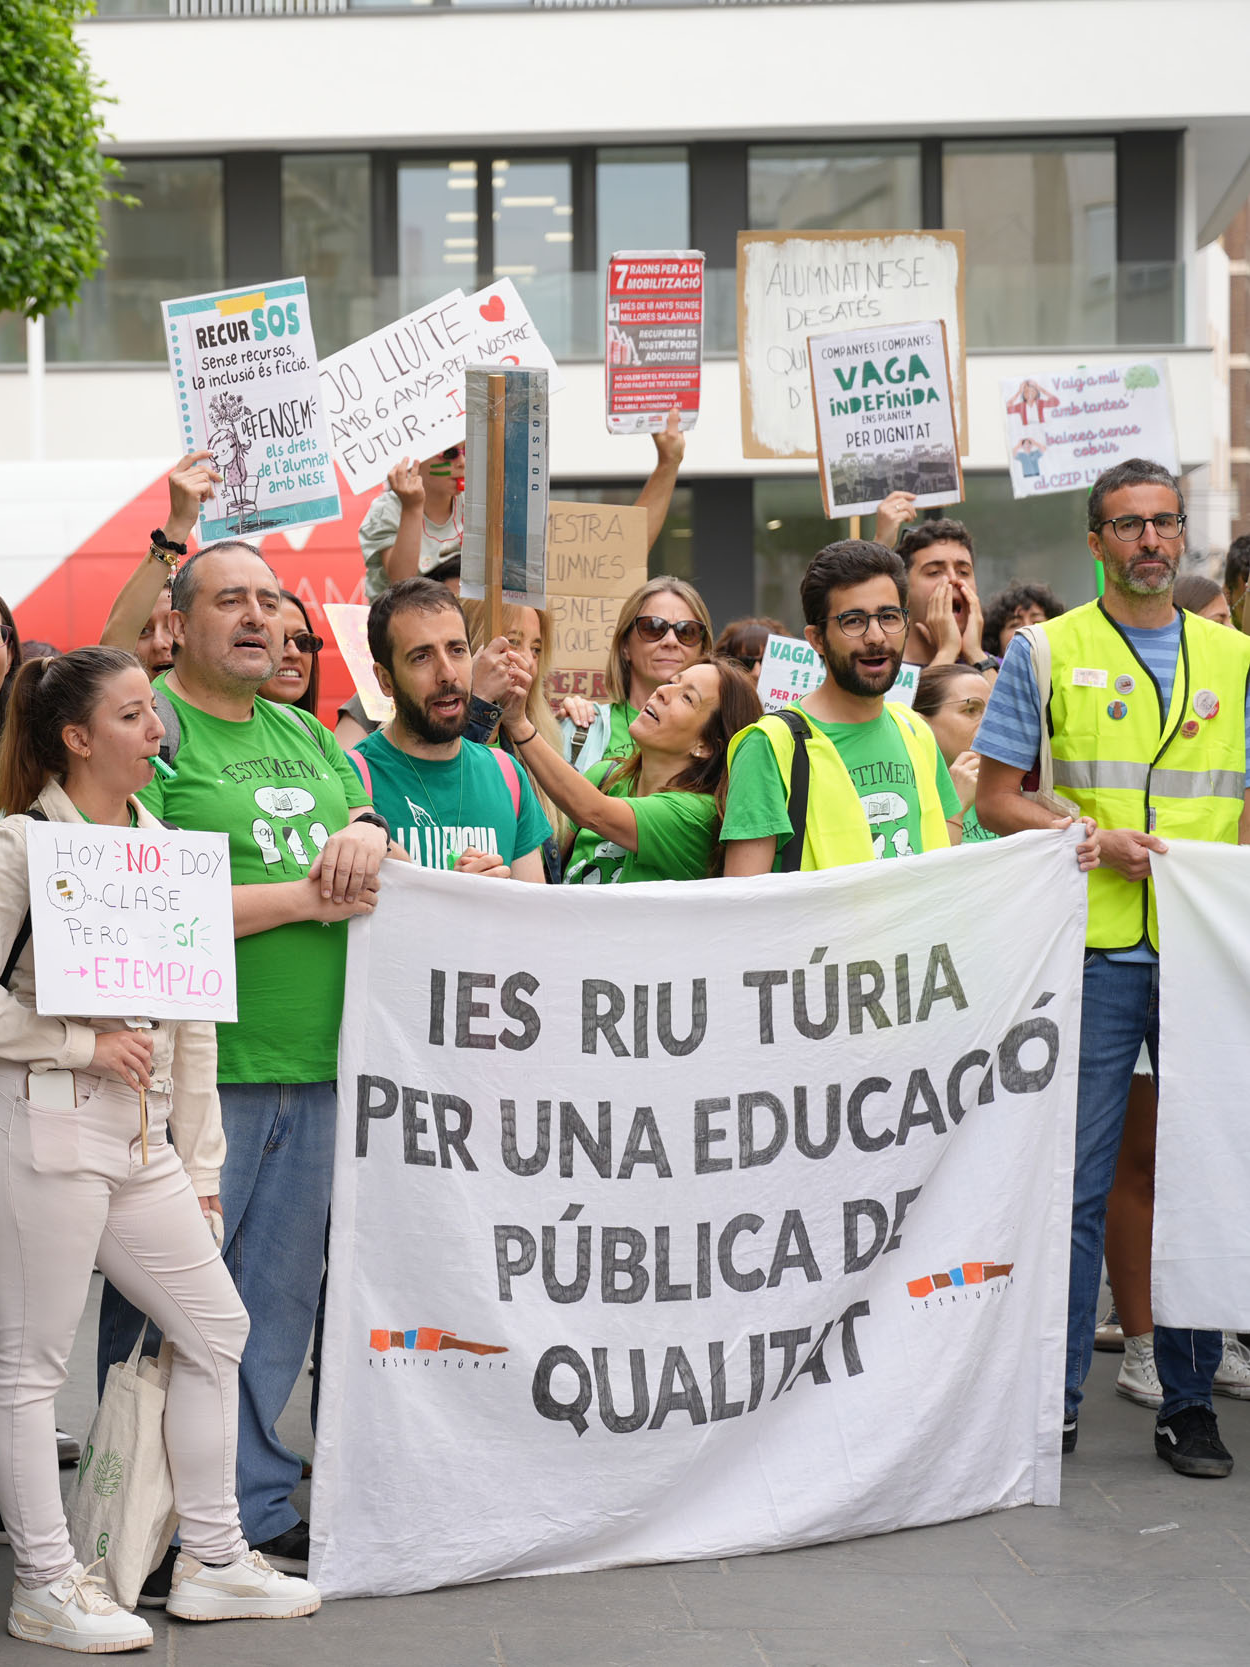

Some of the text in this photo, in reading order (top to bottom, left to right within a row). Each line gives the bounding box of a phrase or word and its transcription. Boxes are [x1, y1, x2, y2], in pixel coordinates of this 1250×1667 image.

[615, 264, 700, 289] 7 RAONS PER A LA
[627, 275, 700, 289] MOBILITZACIÓ
[766, 256, 930, 297] ALUMNAT NESE
[612, 306, 617, 318] 1
[621, 301, 636, 310] MÉS
[637, 302, 646, 310] DE
[655, 301, 673, 309] ANYS
[676, 300, 700, 309] SENSE
[621, 312, 699, 322] MILLORES SALARIALS
[786, 294, 881, 332] DESATÉS
[639, 329, 697, 338] RECUPEREM EL
[639, 340, 698, 350] NOSTRE PODER
[201, 344, 295, 371] Sense recursos,
[822, 335, 934, 359] COMPANYES I COMPANYS:
[192, 358, 310, 390] la inclusió és ficció.
[330, 408, 371, 447] AMB
[375, 397, 388, 418] 6
[478, 323, 531, 360] NOSTRE
[833, 354, 930, 392] VAGA
[1052, 369, 1120, 393] Vaig a mil
[319, 363, 362, 414] JO
[241, 400, 313, 440] DEFENSEM
[862, 409, 912, 424] ENS PLANTEM
[1051, 398, 1129, 418] amb tantes
[846, 423, 930, 448] PER DIGNITAT
[1045, 424, 1141, 446] baixes sense
[266, 438, 317, 459] els drets
[1073, 441, 1119, 457] cobrir
[257, 452, 329, 478] de l'alumnat
[269, 472, 326, 494] amb NESE
[1034, 476, 1049, 490] al
[1050, 472, 1081, 488] CEIP
[547, 551, 625, 581] LUMNES
[770, 641, 814, 666] VAGA
[790, 669, 810, 688] 11
[770, 688, 789, 701] PER
[54, 837, 224, 878] HOY NO DOY
[102, 884, 180, 912] CLASE
[63, 917, 199, 948] PERO SÍ
[95, 956, 222, 996] EJEMPLO
[428, 943, 968, 1058] IES RIU TÚRIA
[354, 991, 1059, 1179] PER UNA EDUCACIÓ
[493, 1203, 822, 1304] PÚBLICA
[532, 1300, 870, 1438] QUALITAT
